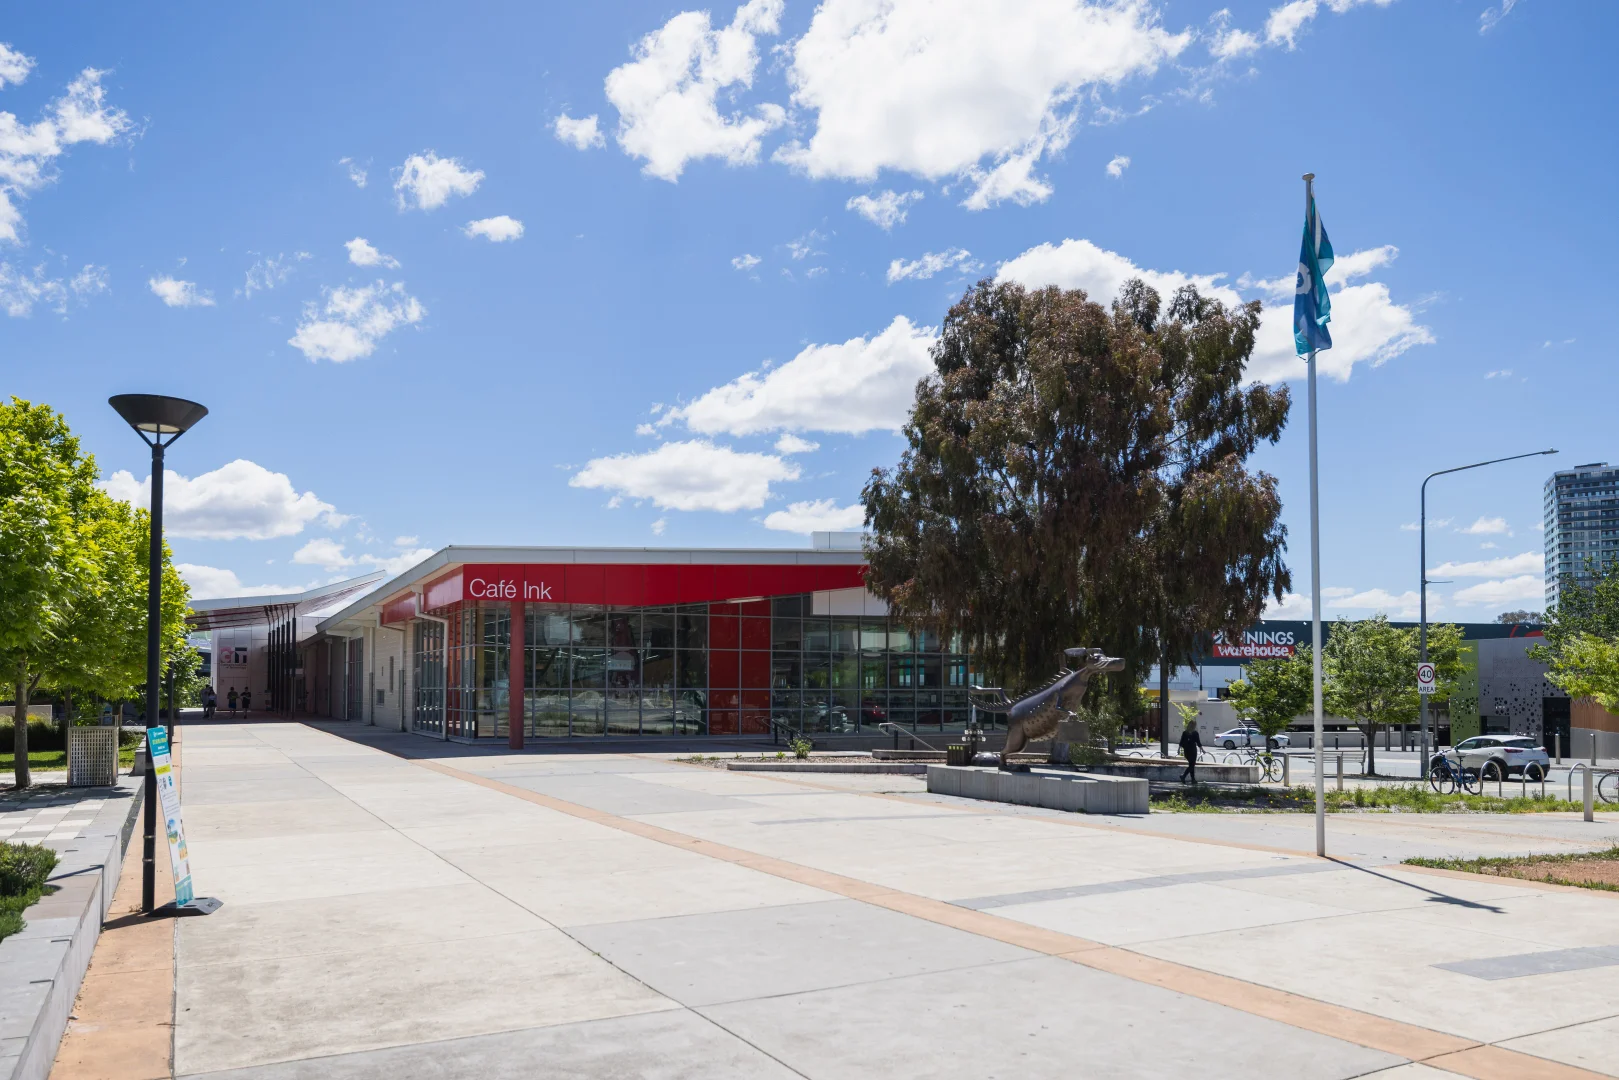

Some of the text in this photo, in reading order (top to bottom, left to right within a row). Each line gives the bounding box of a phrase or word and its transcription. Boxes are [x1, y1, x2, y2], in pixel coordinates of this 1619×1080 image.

[469, 578, 552, 600] Café Ink
[1212, 630, 1295, 645] NINGS
[1218, 642, 1289, 656] warehouse
[1420, 670, 1432, 678] 40
